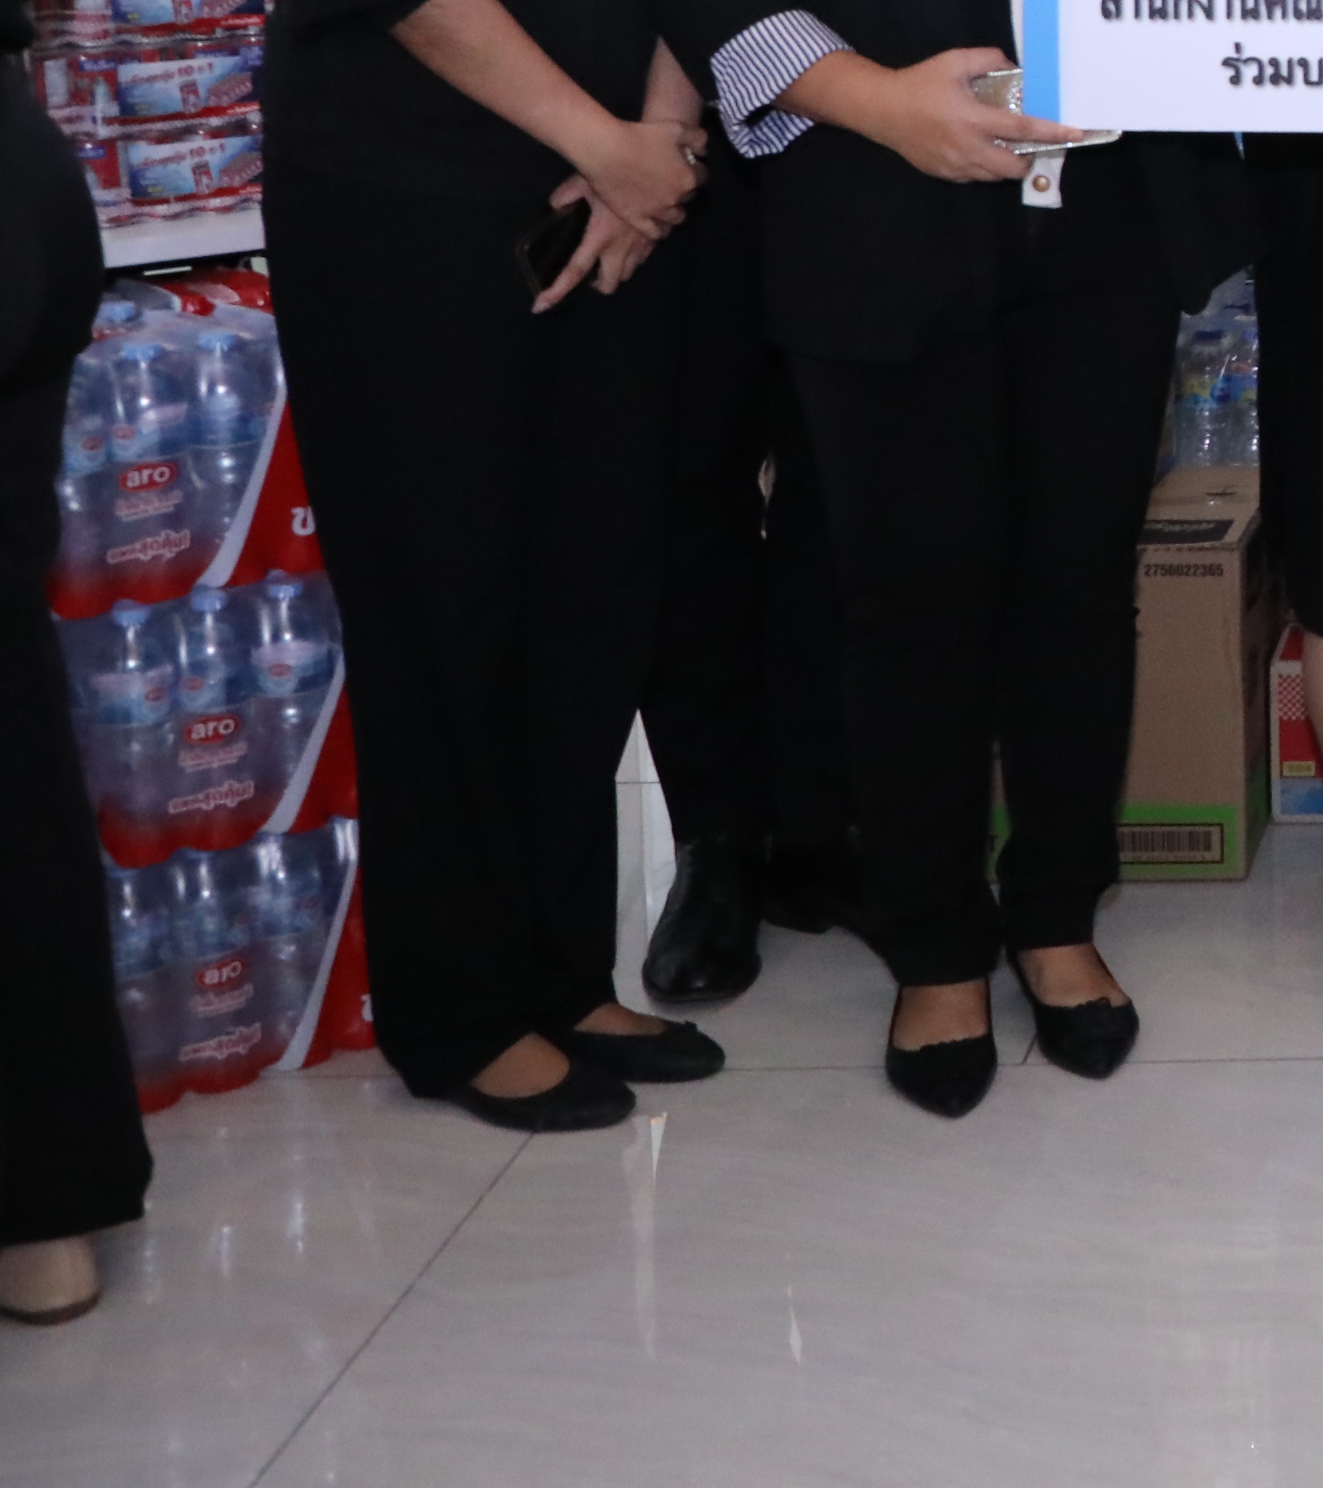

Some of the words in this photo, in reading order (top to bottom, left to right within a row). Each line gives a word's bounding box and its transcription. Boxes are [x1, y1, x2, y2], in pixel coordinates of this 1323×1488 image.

[126, 466, 170, 488] aro
[191, 718, 235, 740] aro
[203, 961, 242, 985] aro
